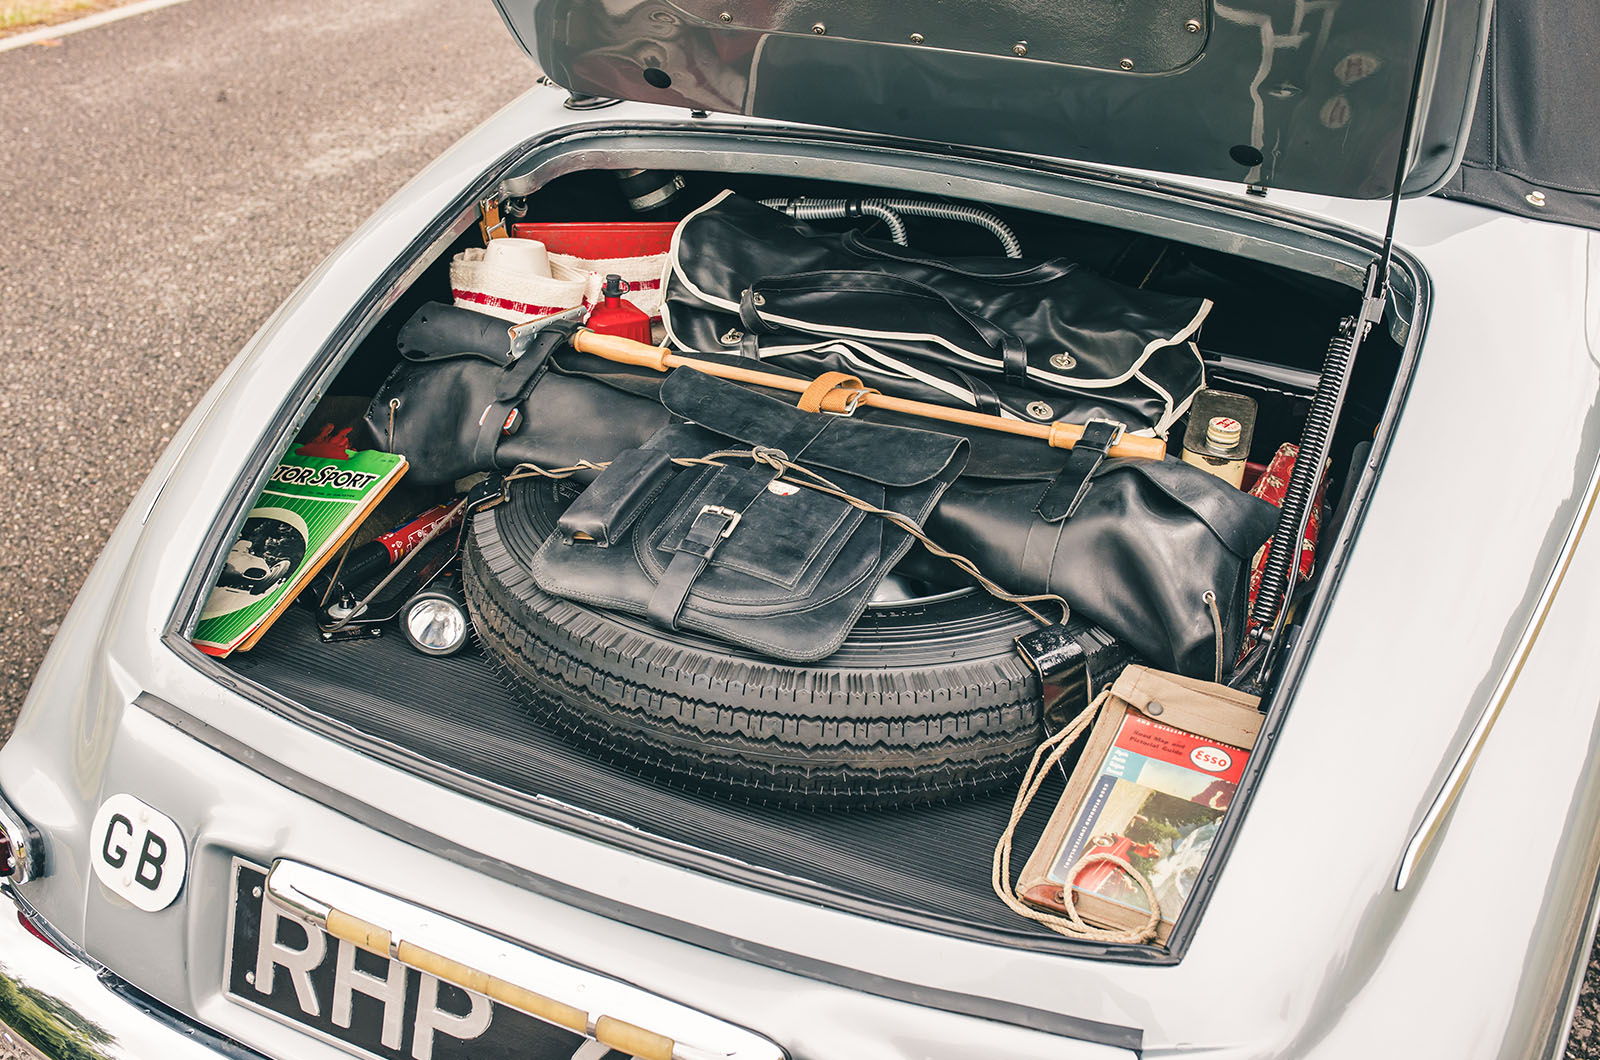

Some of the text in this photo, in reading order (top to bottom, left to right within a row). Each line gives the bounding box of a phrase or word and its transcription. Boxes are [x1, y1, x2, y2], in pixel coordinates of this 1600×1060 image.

[271, 465, 378, 489] TOR SPORT
[1194, 751, 1228, 768] ESSO
[103, 813, 167, 891] GB
